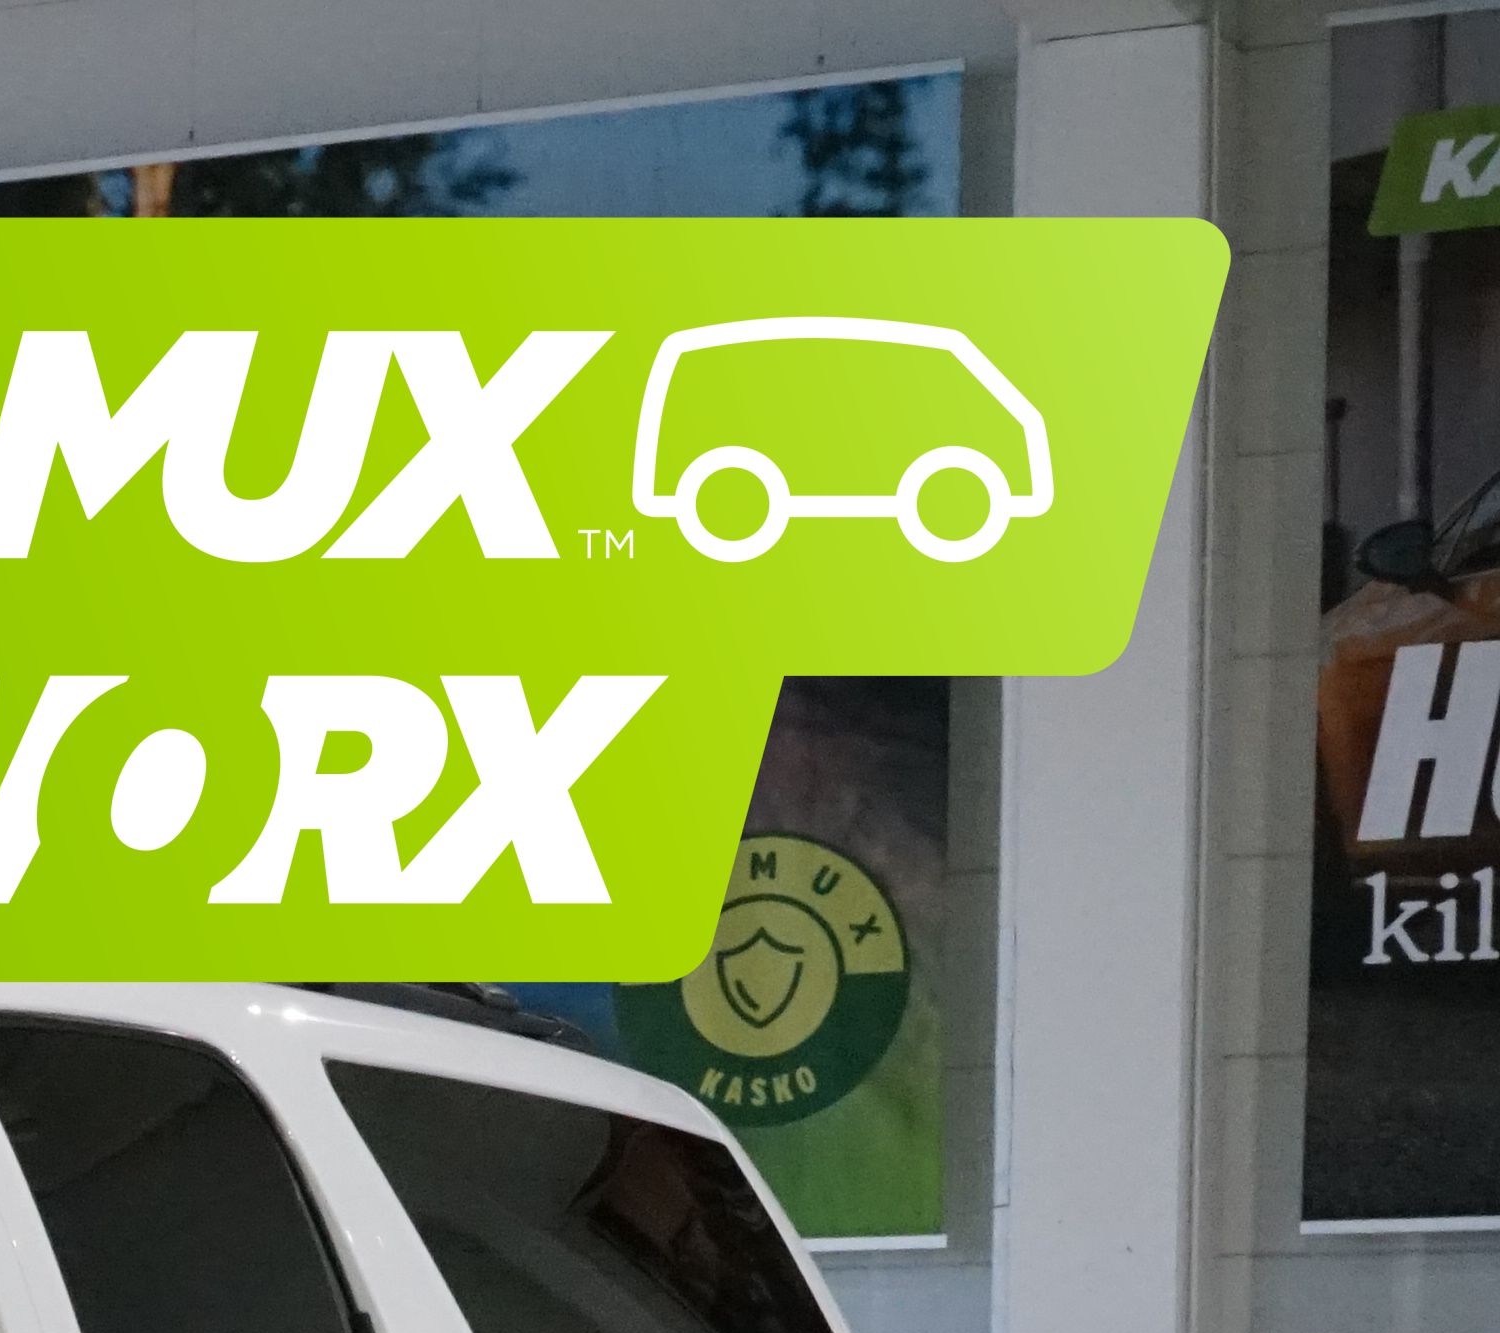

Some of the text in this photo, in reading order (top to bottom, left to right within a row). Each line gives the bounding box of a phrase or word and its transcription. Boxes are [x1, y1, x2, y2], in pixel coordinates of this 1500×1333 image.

[1357, 640, 1500, 841] H
[749, 851, 882, 945] MUX
[700, 1066, 818, 1107] KASKO
